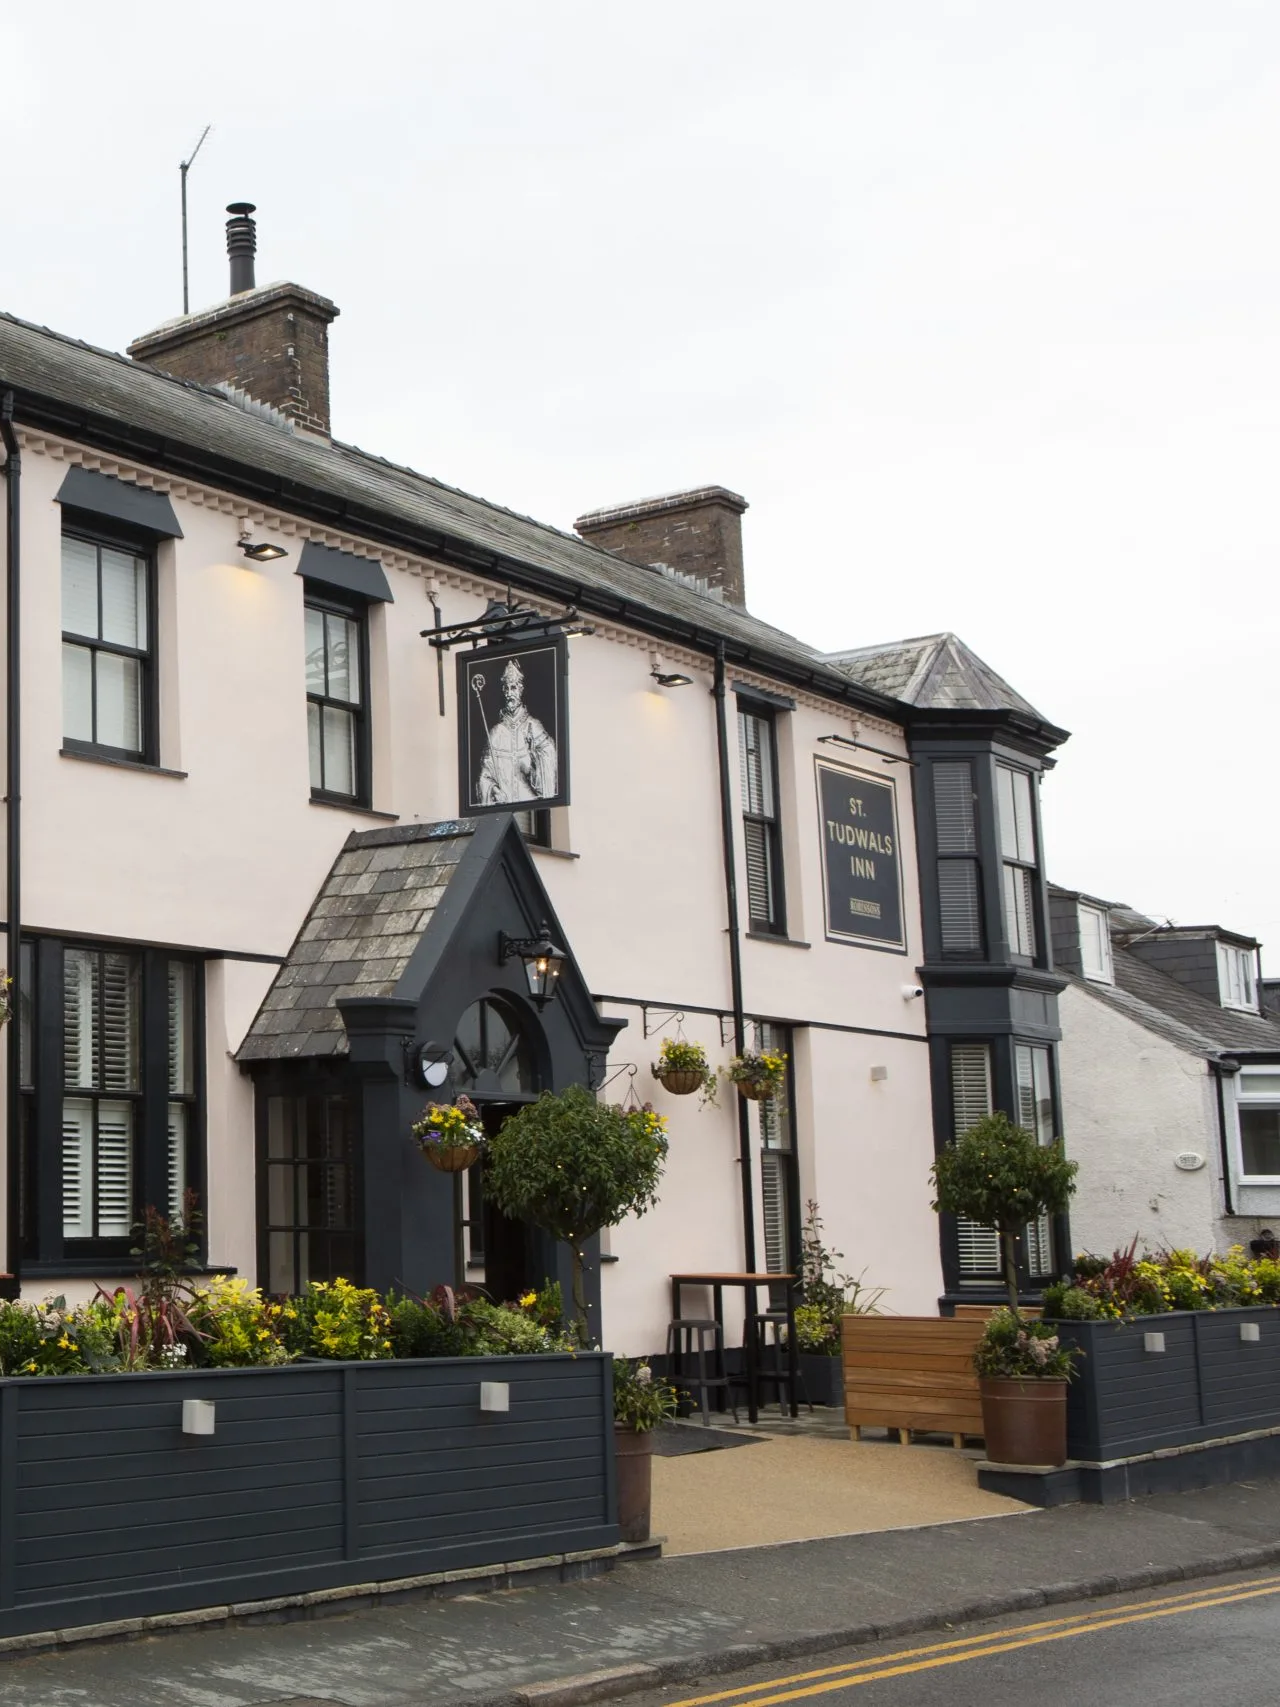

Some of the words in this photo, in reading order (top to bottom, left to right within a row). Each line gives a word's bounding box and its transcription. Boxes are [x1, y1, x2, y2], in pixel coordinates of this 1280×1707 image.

[849, 797, 866, 816] ST.
[827, 820, 893, 856] TUDWALS
[850, 856, 875, 880] INN
